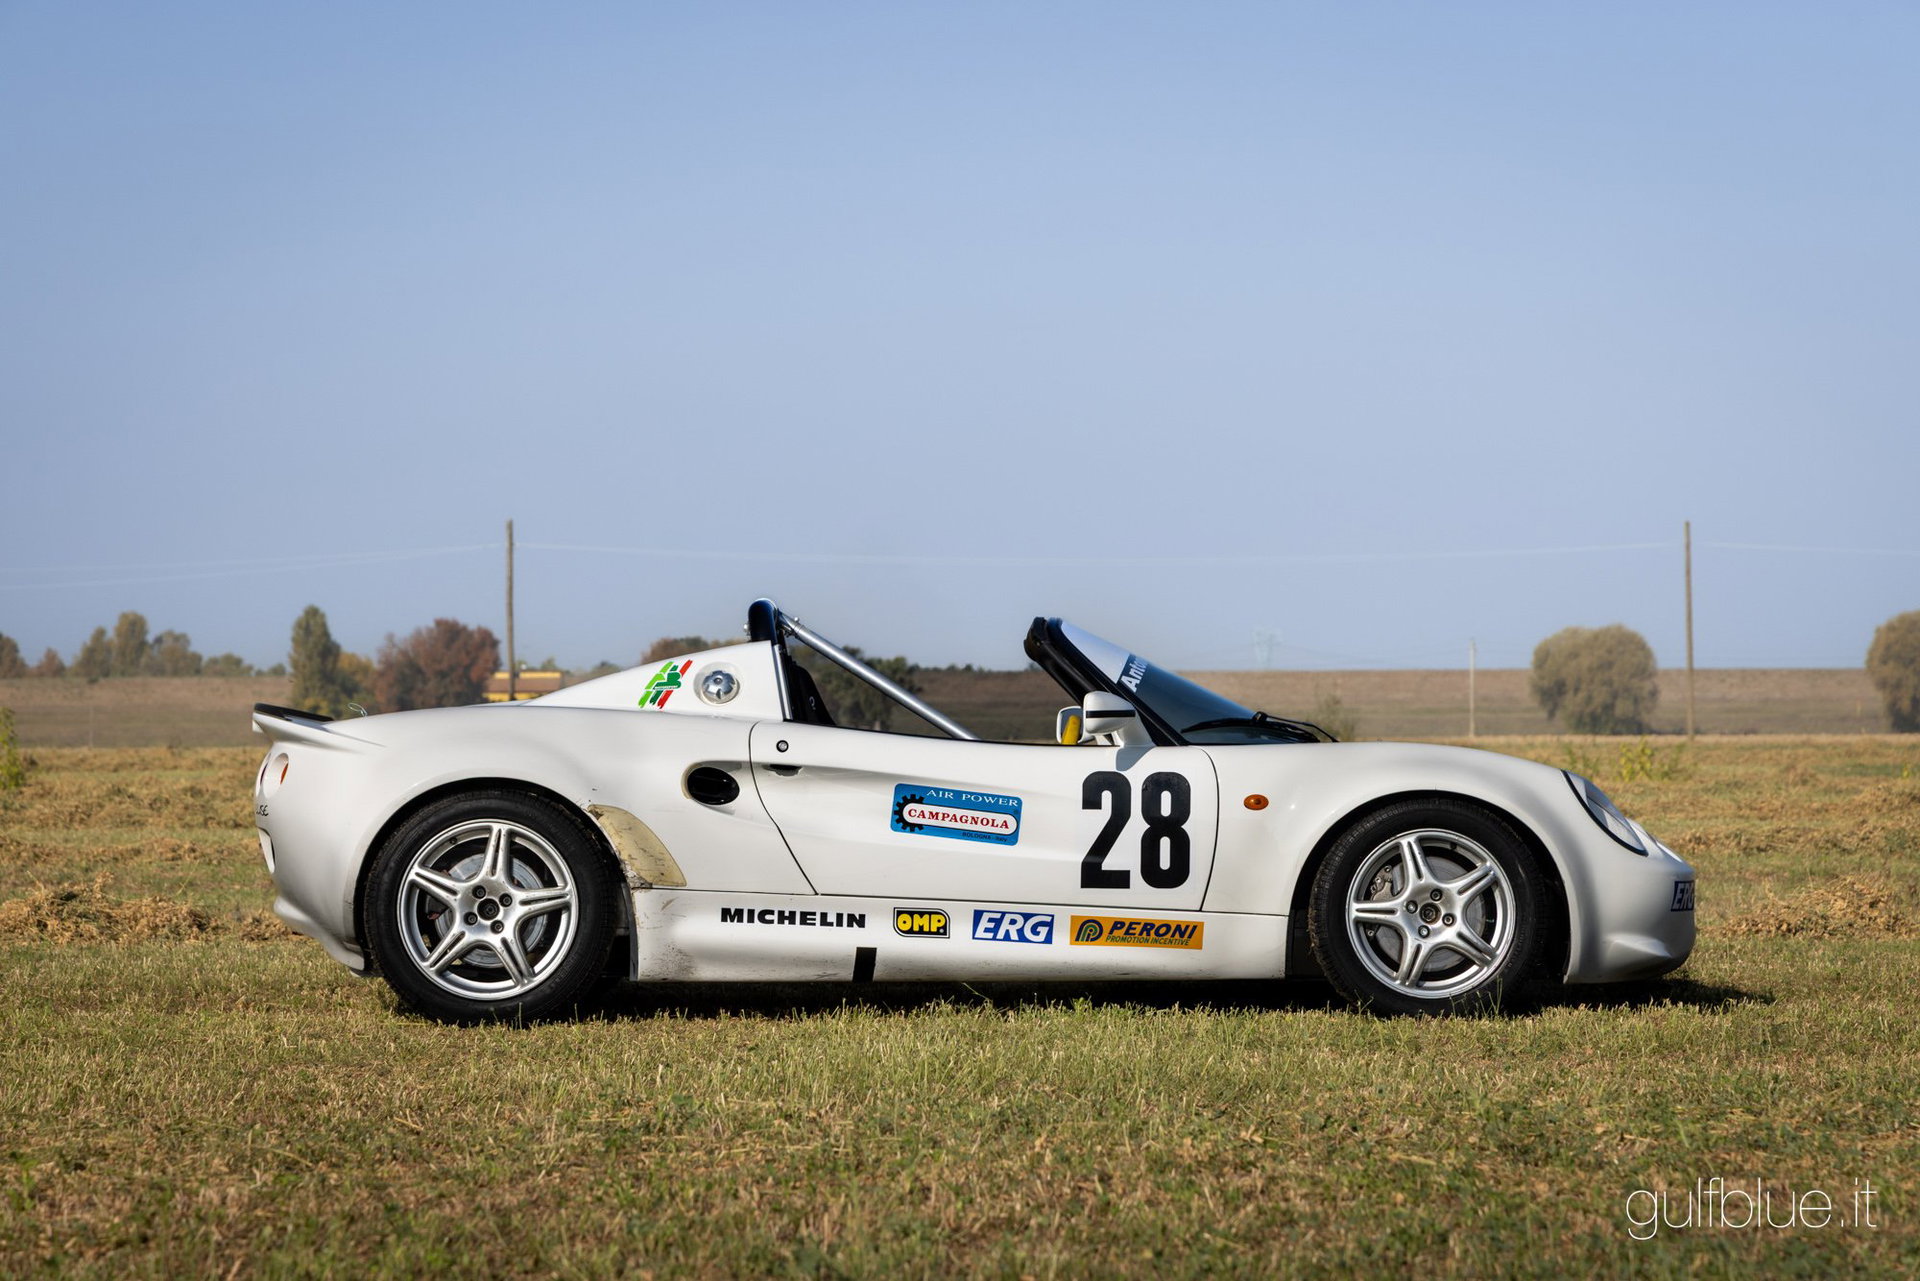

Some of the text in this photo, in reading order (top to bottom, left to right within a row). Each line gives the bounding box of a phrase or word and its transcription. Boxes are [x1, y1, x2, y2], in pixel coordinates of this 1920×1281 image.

[926, 789, 1018, 807] AIR POWER
[908, 808, 1010, 830] CAMPAGNOLA
[1080, 771, 1191, 889] 28
[721, 908, 866, 928] MICHELIN
[897, 913, 946, 932] OMP
[974, 911, 1052, 942] ERG
[1106, 934, 1191, 946] PROMOTION INCENTIVE
[1108, 921, 1198, 940] PERONI
